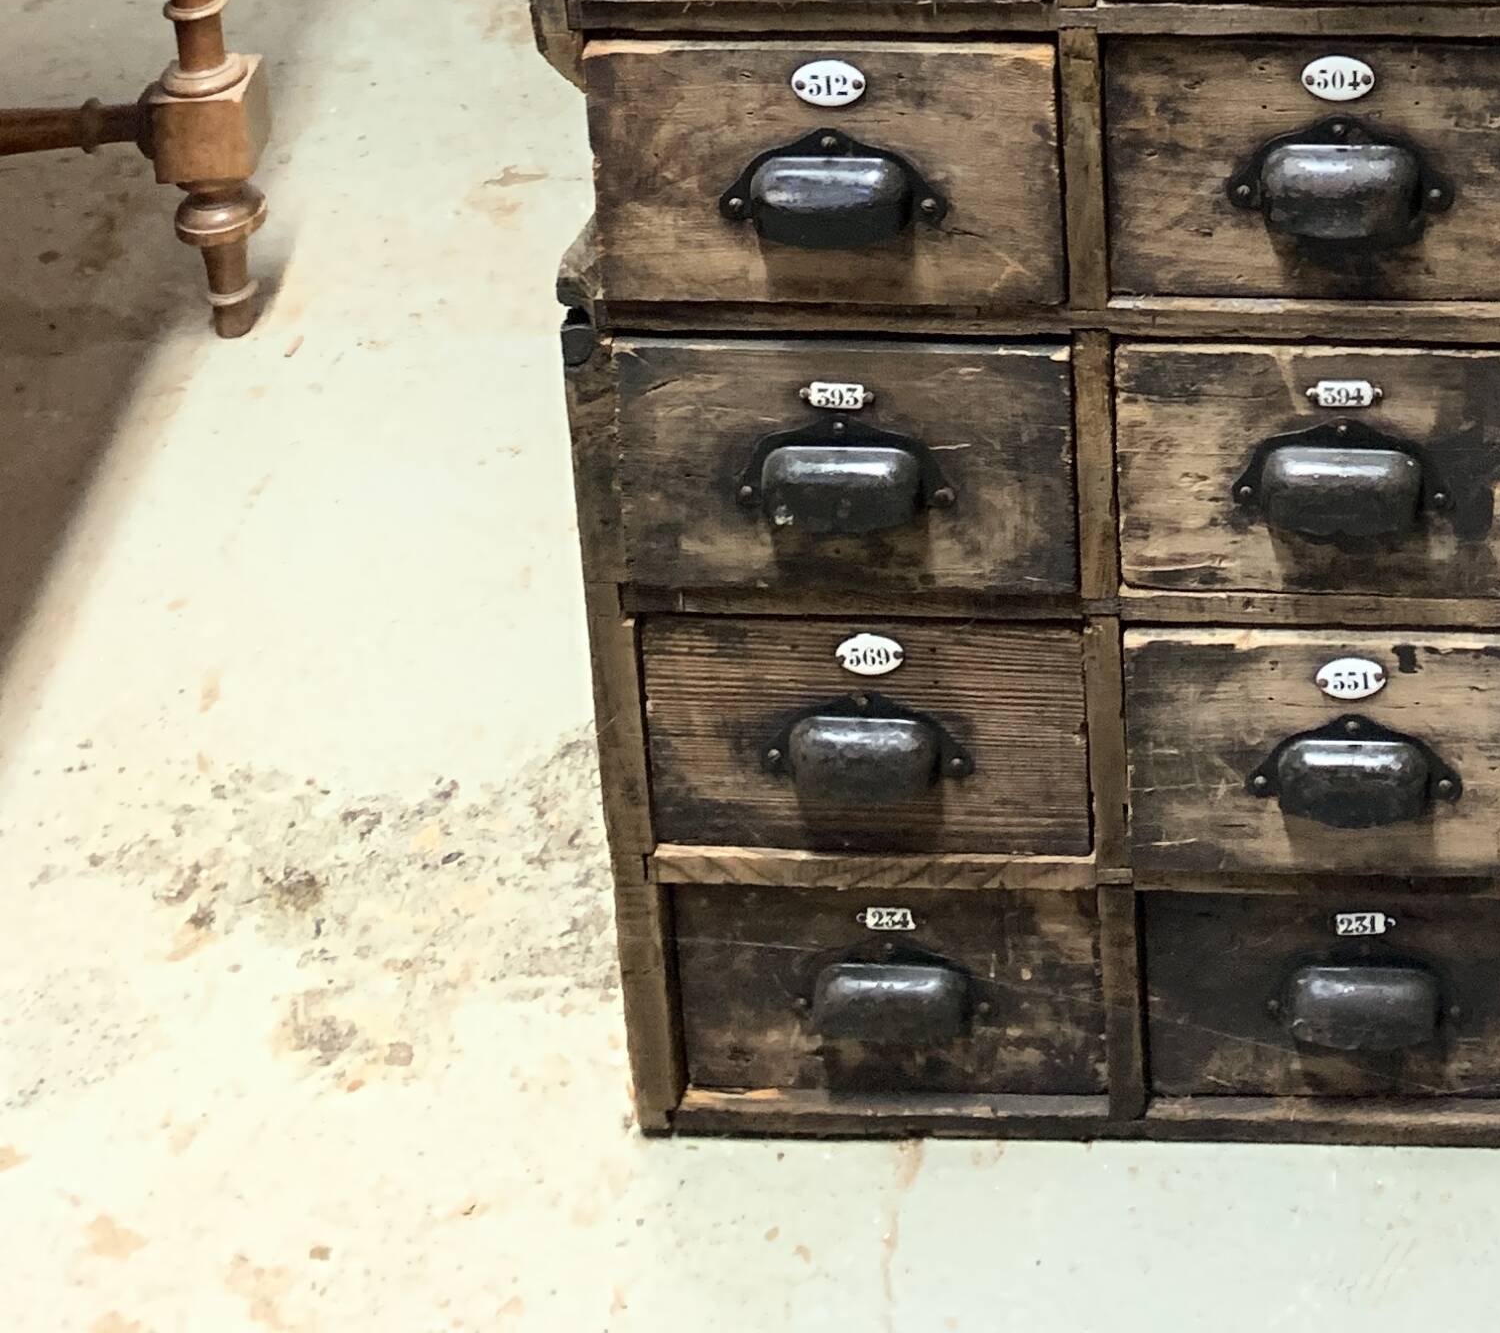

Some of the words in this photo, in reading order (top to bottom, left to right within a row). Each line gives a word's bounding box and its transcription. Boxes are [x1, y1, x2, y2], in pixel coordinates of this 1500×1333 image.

[809, 75, 848, 96] 512
[1317, 69, 1361, 91] 504
[817, 387, 859, 407] 393
[849, 647, 890, 667] 569
[1333, 671, 1370, 691] 551
[871, 911, 910, 929] 234
[1338, 915, 1377, 934] 231
